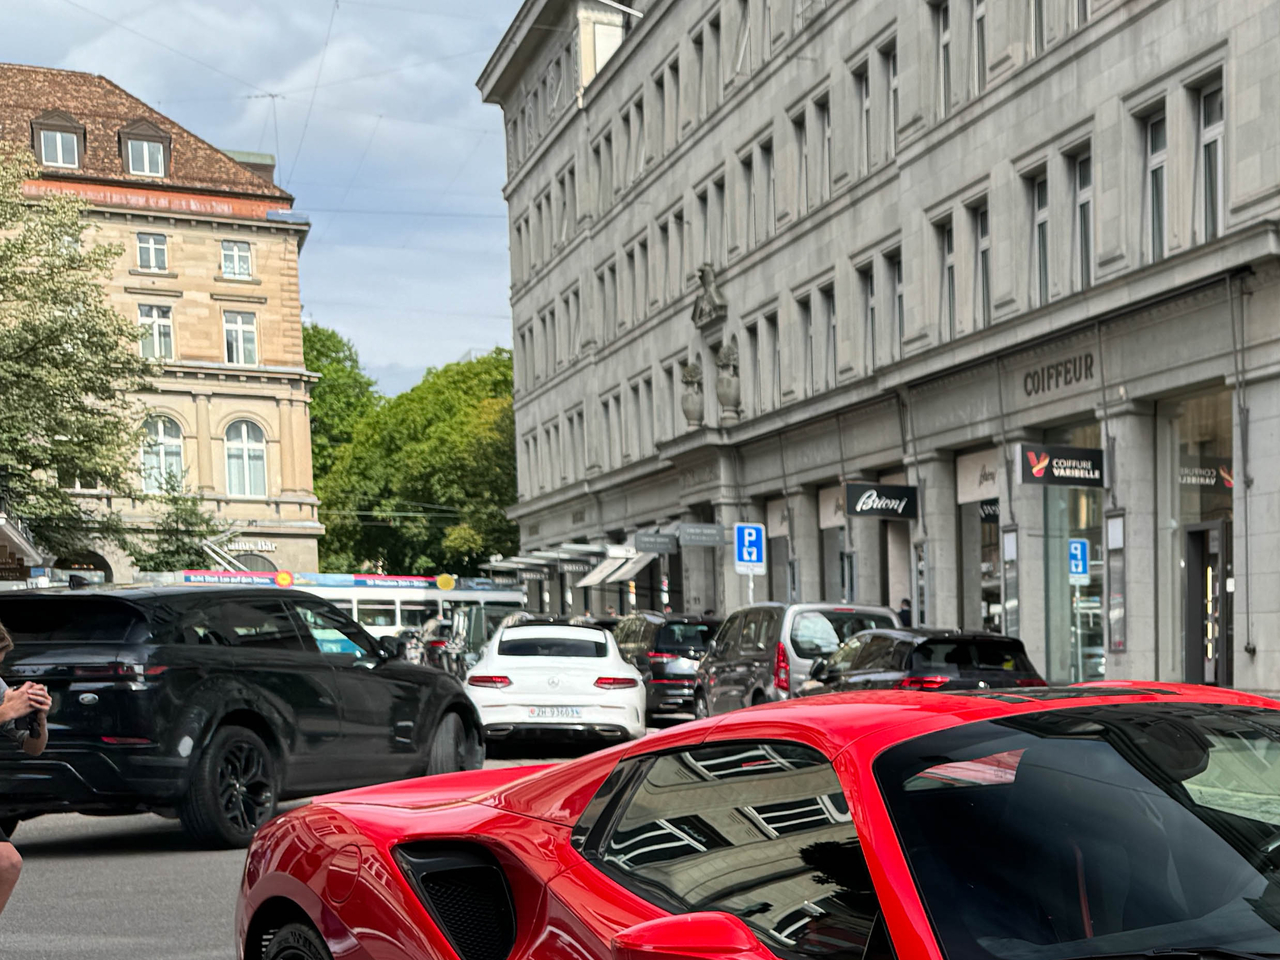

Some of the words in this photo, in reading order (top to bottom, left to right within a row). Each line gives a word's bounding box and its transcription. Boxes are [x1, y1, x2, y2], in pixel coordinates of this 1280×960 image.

[1024, 353, 1094, 397] COIFFEUR
[1052, 458, 1092, 470] COIFFURE
[1052, 468, 1100, 479] VARIBELLE
[855, 488, 908, 514] Brioni
[744, 528, 757, 547] P
